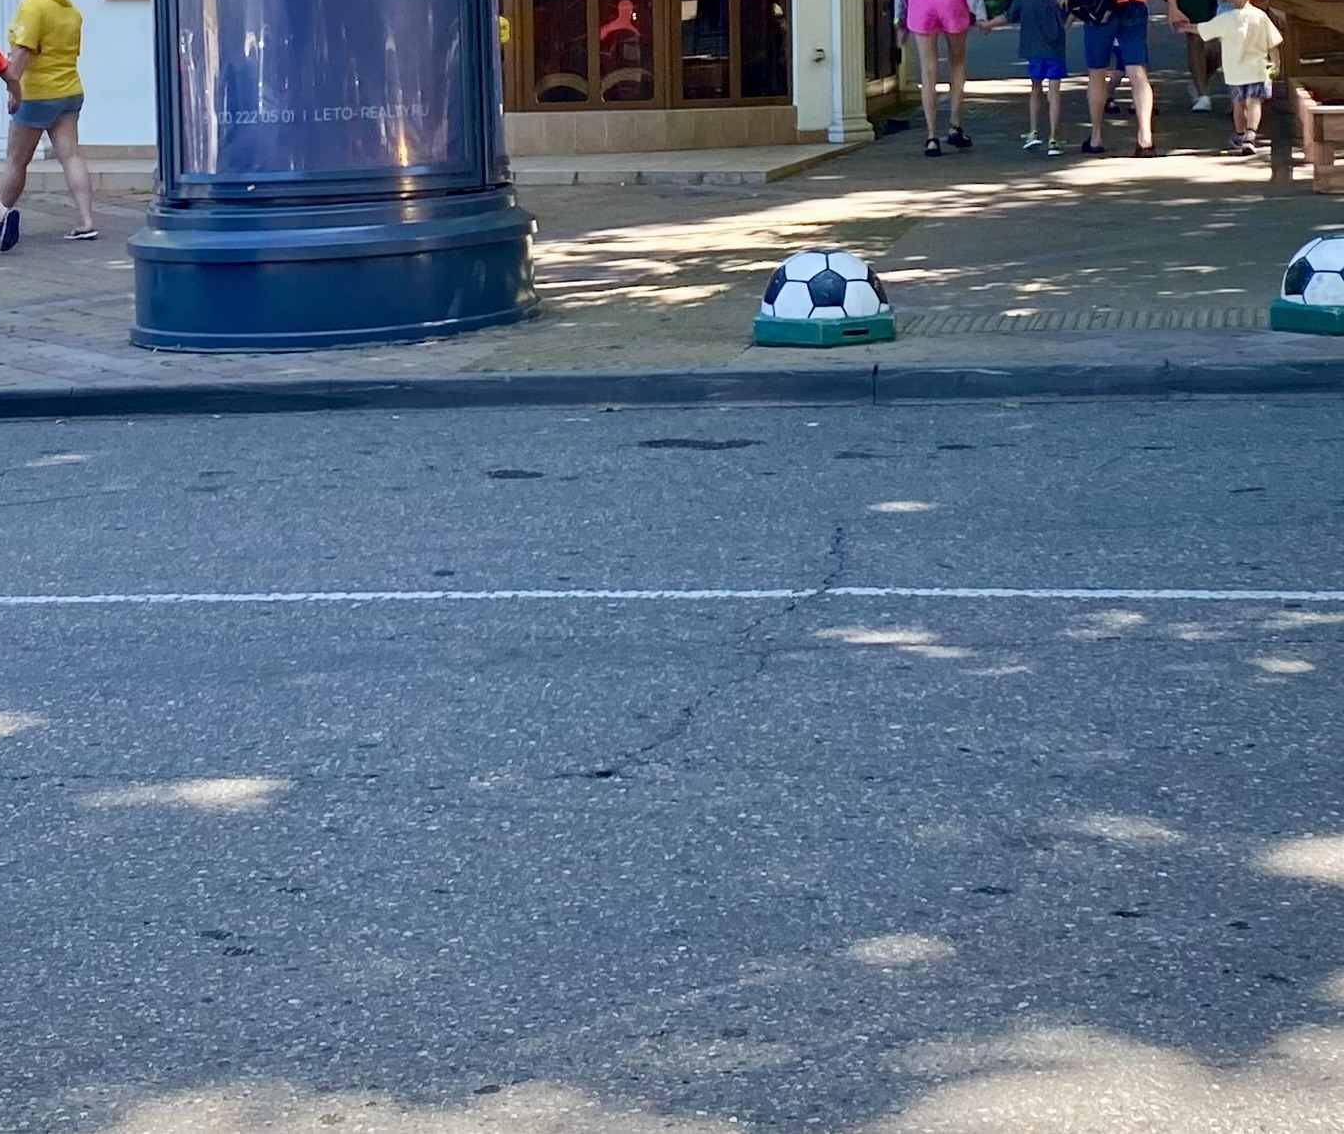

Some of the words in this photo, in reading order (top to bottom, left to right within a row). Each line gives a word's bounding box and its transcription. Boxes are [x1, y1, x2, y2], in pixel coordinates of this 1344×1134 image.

[235, 109, 257, 125] 222
[260, 109, 279, 123] 05
[281, 109, 294, 123] 01
[314, 103, 430, 121] LETO-REALTYRU
